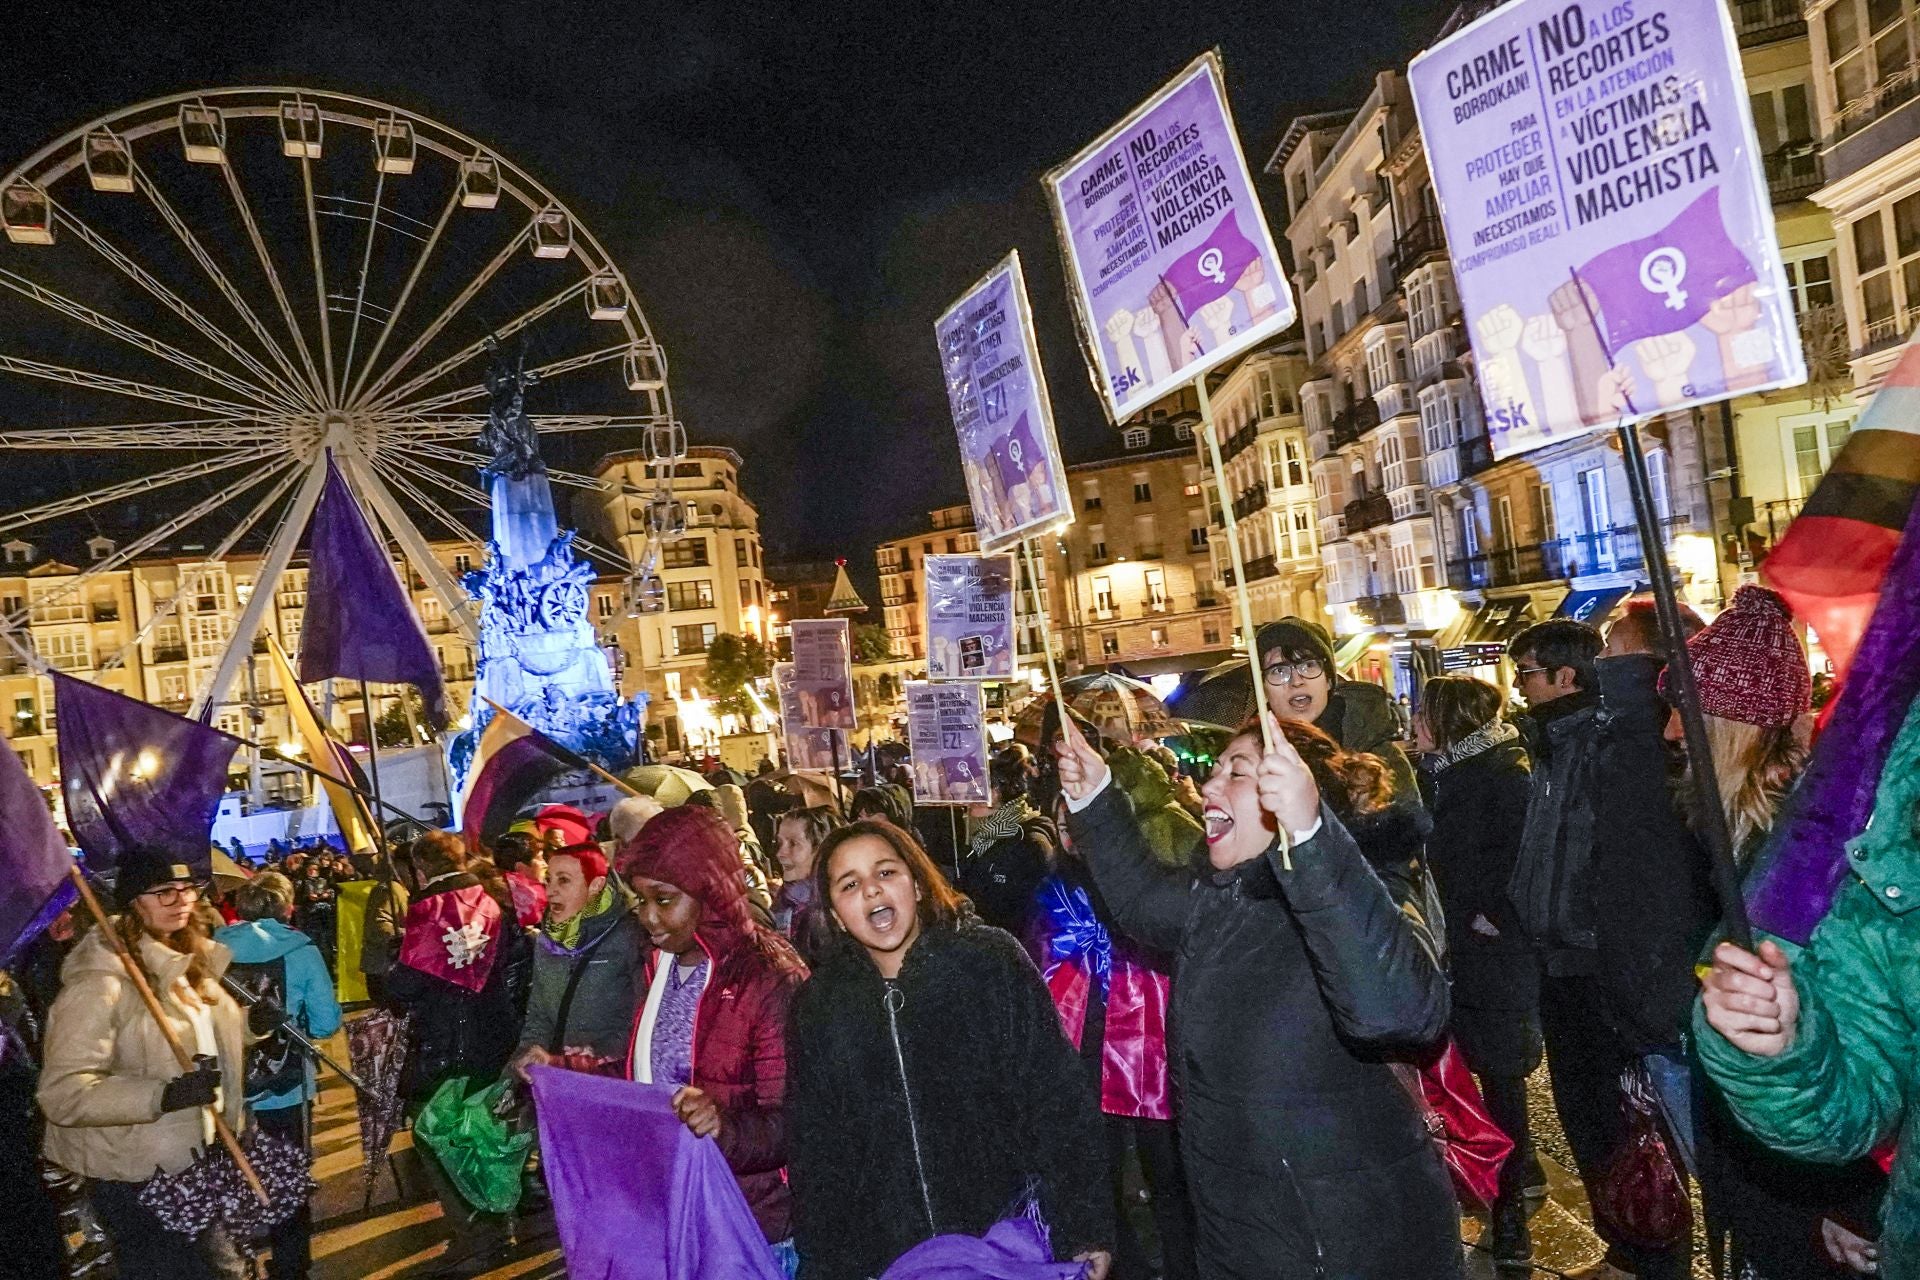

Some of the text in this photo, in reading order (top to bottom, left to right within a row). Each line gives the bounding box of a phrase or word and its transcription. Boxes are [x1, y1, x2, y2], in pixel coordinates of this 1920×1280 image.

[1539, 0, 1634, 62] NO A LOS
[1446, 35, 1525, 100] CARME
[1548, 12, 1670, 95] RECORTES
[1453, 71, 1530, 125] BORROKAN!
[1555, 95, 1574, 119] EN
[1577, 86, 1596, 109] LA
[1571, 74, 1682, 146] VÍCTIMAS
[1130, 121, 1181, 162] NO A LOS
[1510, 113, 1537, 135] PARA
[1567, 100, 1711, 186] VIOLENCIA
[1137, 123, 1200, 179] RECORTES
[1465, 130, 1543, 182] PROTEGER
[1499, 154, 1546, 187] HAY QUE
[1081, 152, 1124, 196] CARME
[1142, 179, 1153, 192] EN
[1153, 169, 1165, 183] LA
[1150, 164, 1226, 227] VIOLENCIA
[1574, 142, 1720, 225] MACHISTA
[1157, 185, 1234, 249] MACHISTA
[1485, 174, 1552, 219] AMPLIAR
[1093, 201, 1137, 241] PROTEGER
[1106, 224, 1144, 260] AMPLIAR
[1459, 235, 1527, 273] COMPROMISO
[982, 382, 1008, 425] EZ!
[967, 565, 980, 577] NO
[969, 602, 1005, 613] VIOLENCIA
[969, 613, 1006, 623] MACHISTA
[942, 732, 962, 750] EZ!
